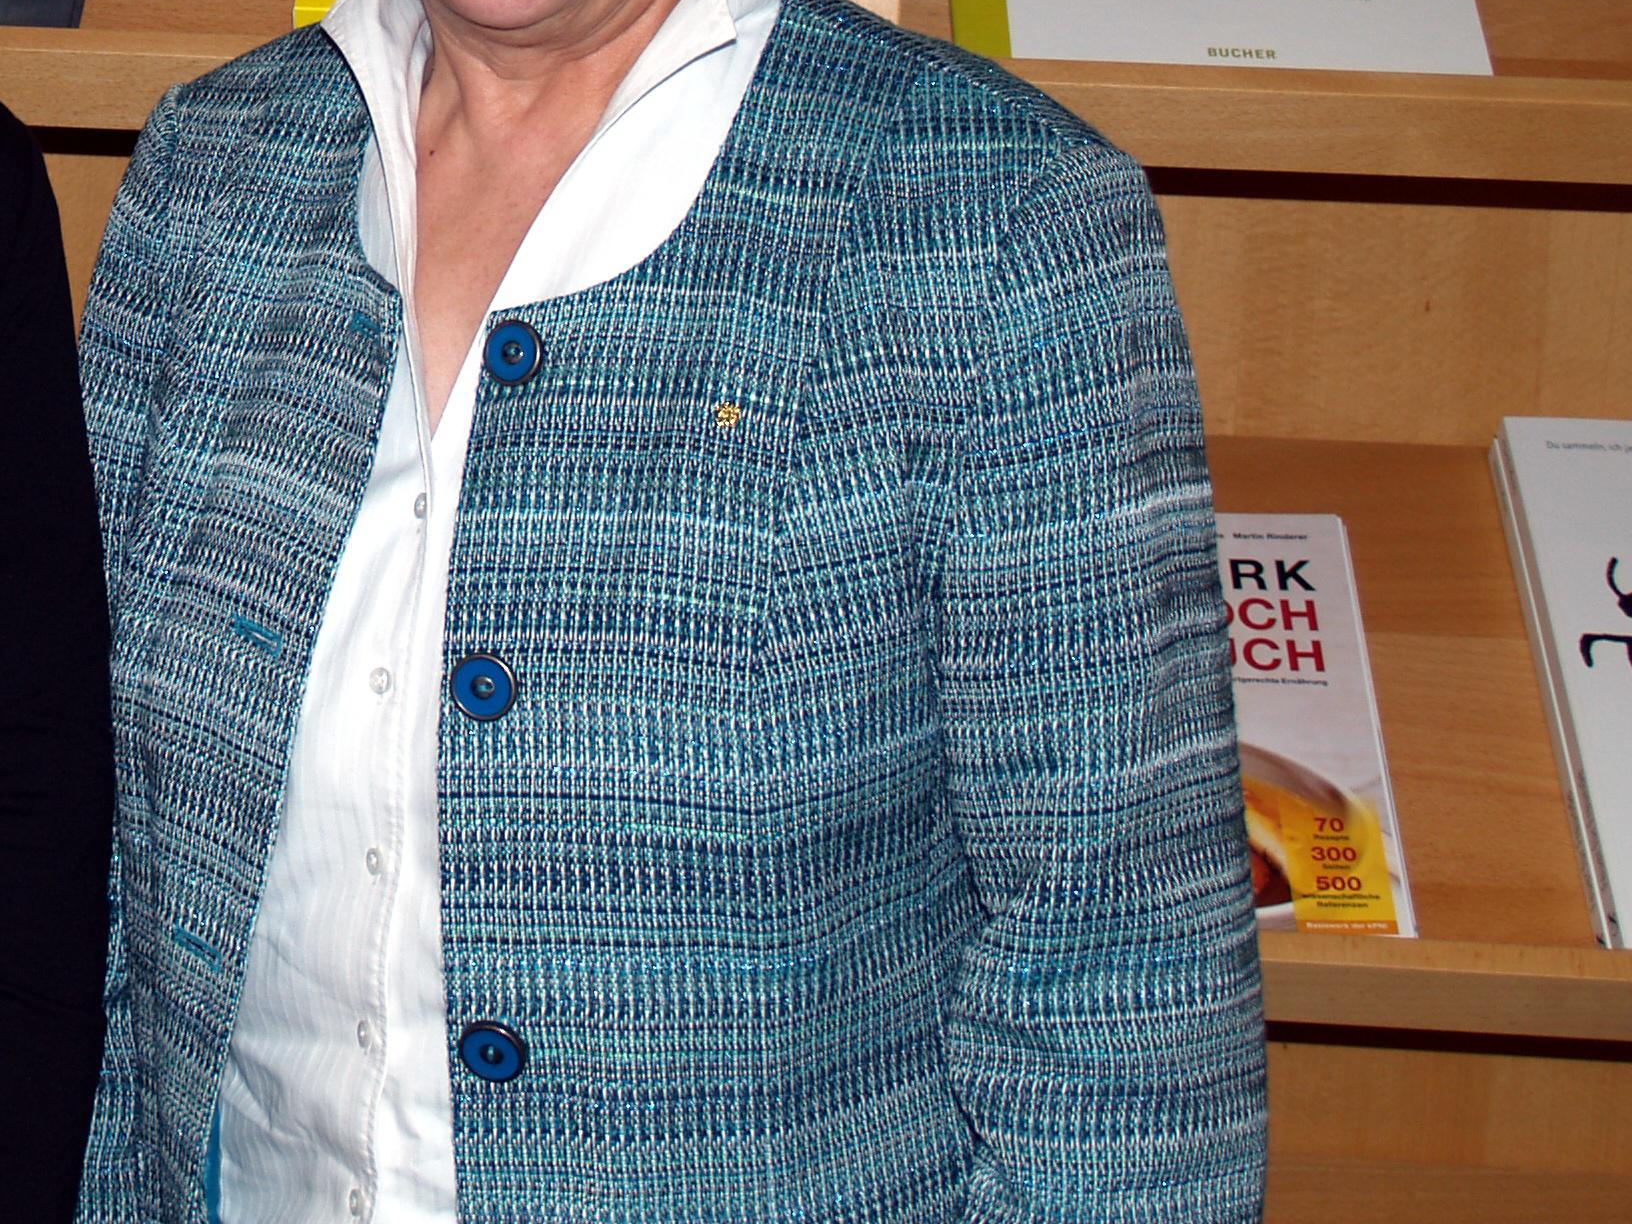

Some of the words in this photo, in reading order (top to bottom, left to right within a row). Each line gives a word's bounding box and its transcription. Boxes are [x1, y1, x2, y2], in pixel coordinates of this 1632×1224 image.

[1207, 47, 1276, 60] BUCHER
[1232, 532, 1264, 540] Martin
[1224, 598, 1319, 631] CH
[1314, 817, 1344, 832] 70
[1311, 846, 1357, 862] 300
[1316, 876, 1362, 891] 500
